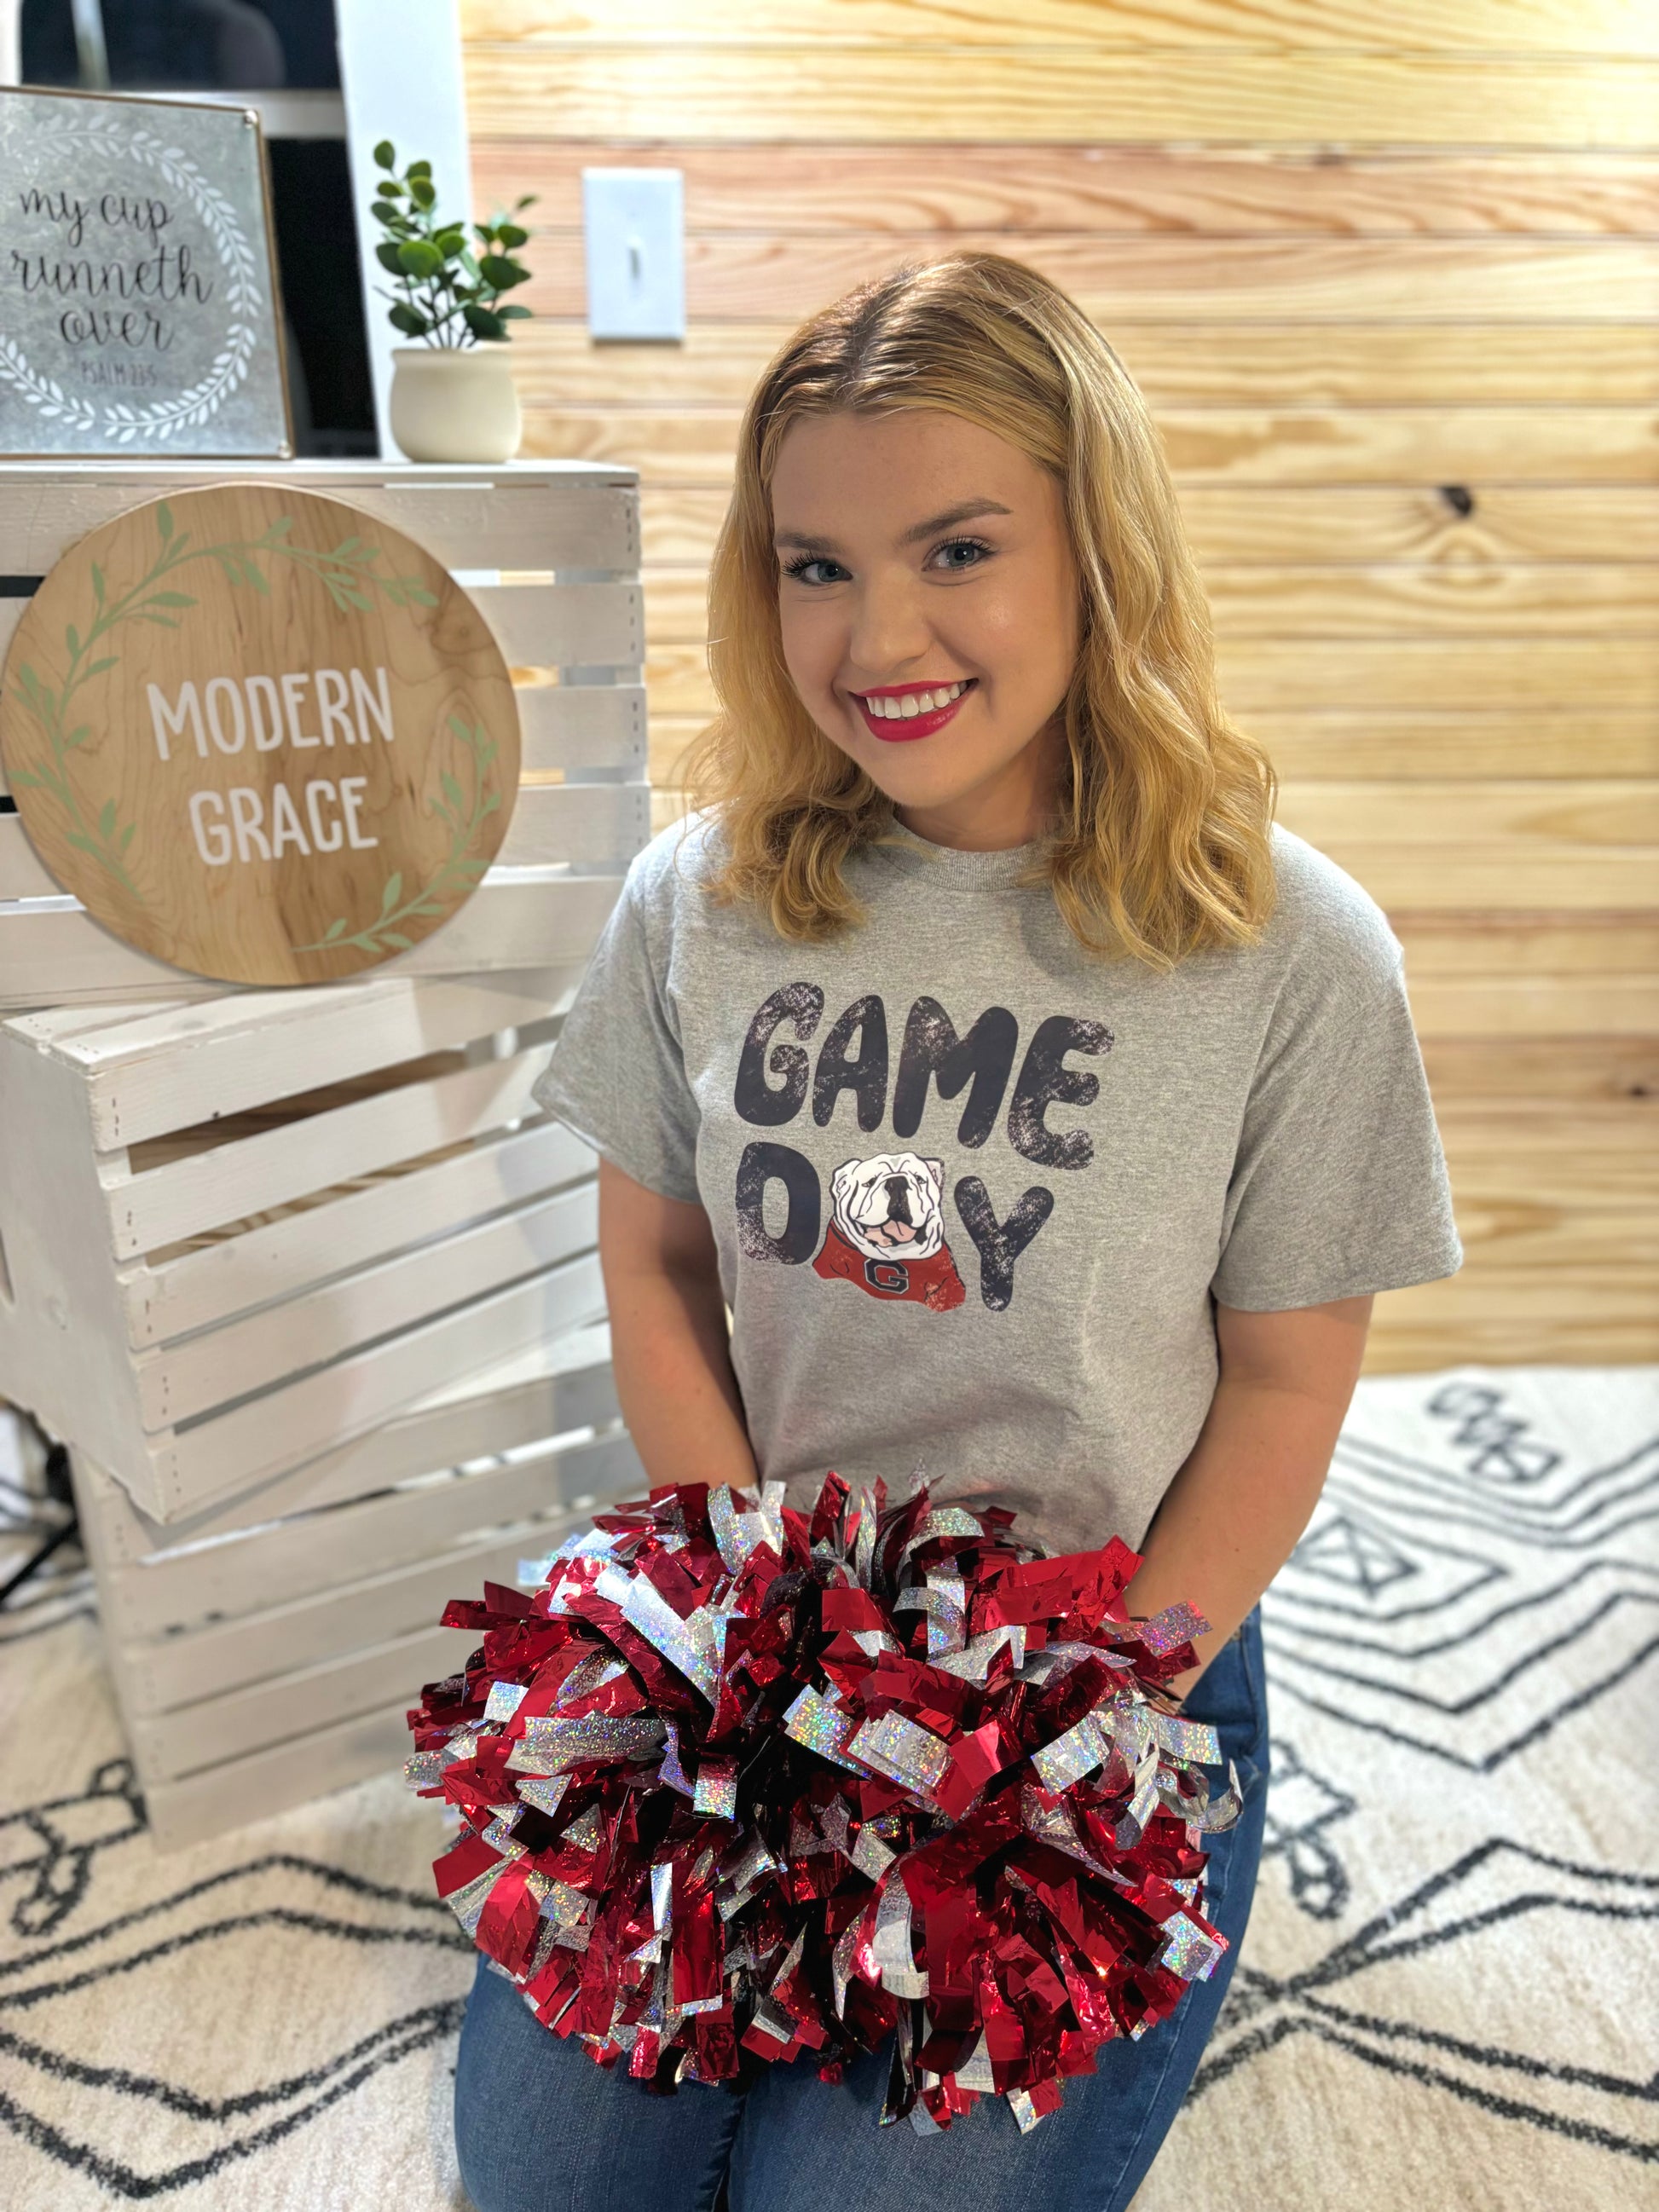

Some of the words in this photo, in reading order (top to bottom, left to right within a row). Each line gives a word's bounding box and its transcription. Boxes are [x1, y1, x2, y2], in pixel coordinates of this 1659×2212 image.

[20, 188, 88, 248] my
[100, 192, 174, 248] cup
[11, 244, 212, 305] runneth
[59, 309, 174, 352] over
[147, 667, 395, 761] MODERN
[188, 777, 379, 866] GRACE
[734, 981, 1115, 1171] GAME
[735, 1141, 1055, 1313] DY
[865, 1258, 910, 1296] G
